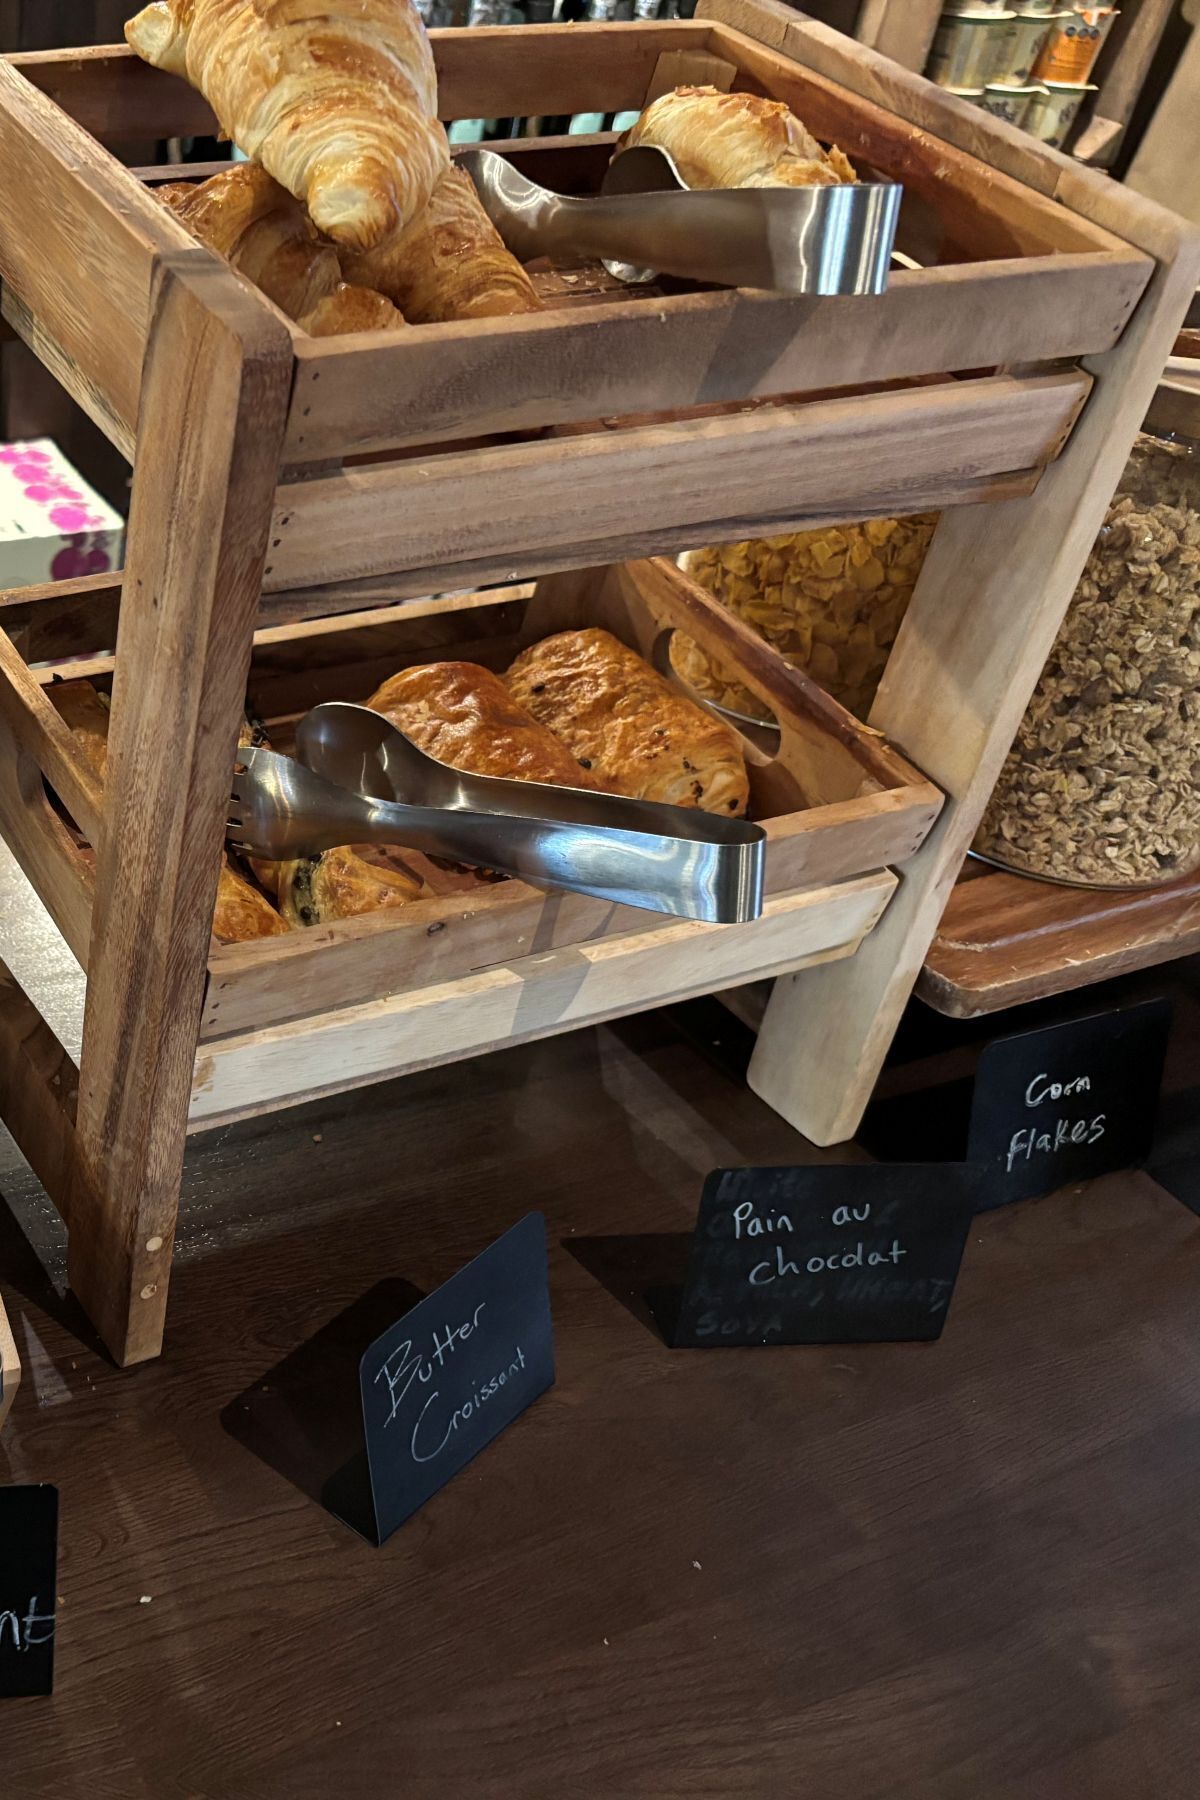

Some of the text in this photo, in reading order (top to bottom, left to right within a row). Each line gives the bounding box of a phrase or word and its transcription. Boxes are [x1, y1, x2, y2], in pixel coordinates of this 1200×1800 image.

[1025, 1073, 1091, 1108] Corn
[733, 1201, 871, 1240] Pain au
[374, 1303, 486, 1428] Butter
[411, 1347, 527, 1462] Croissant
